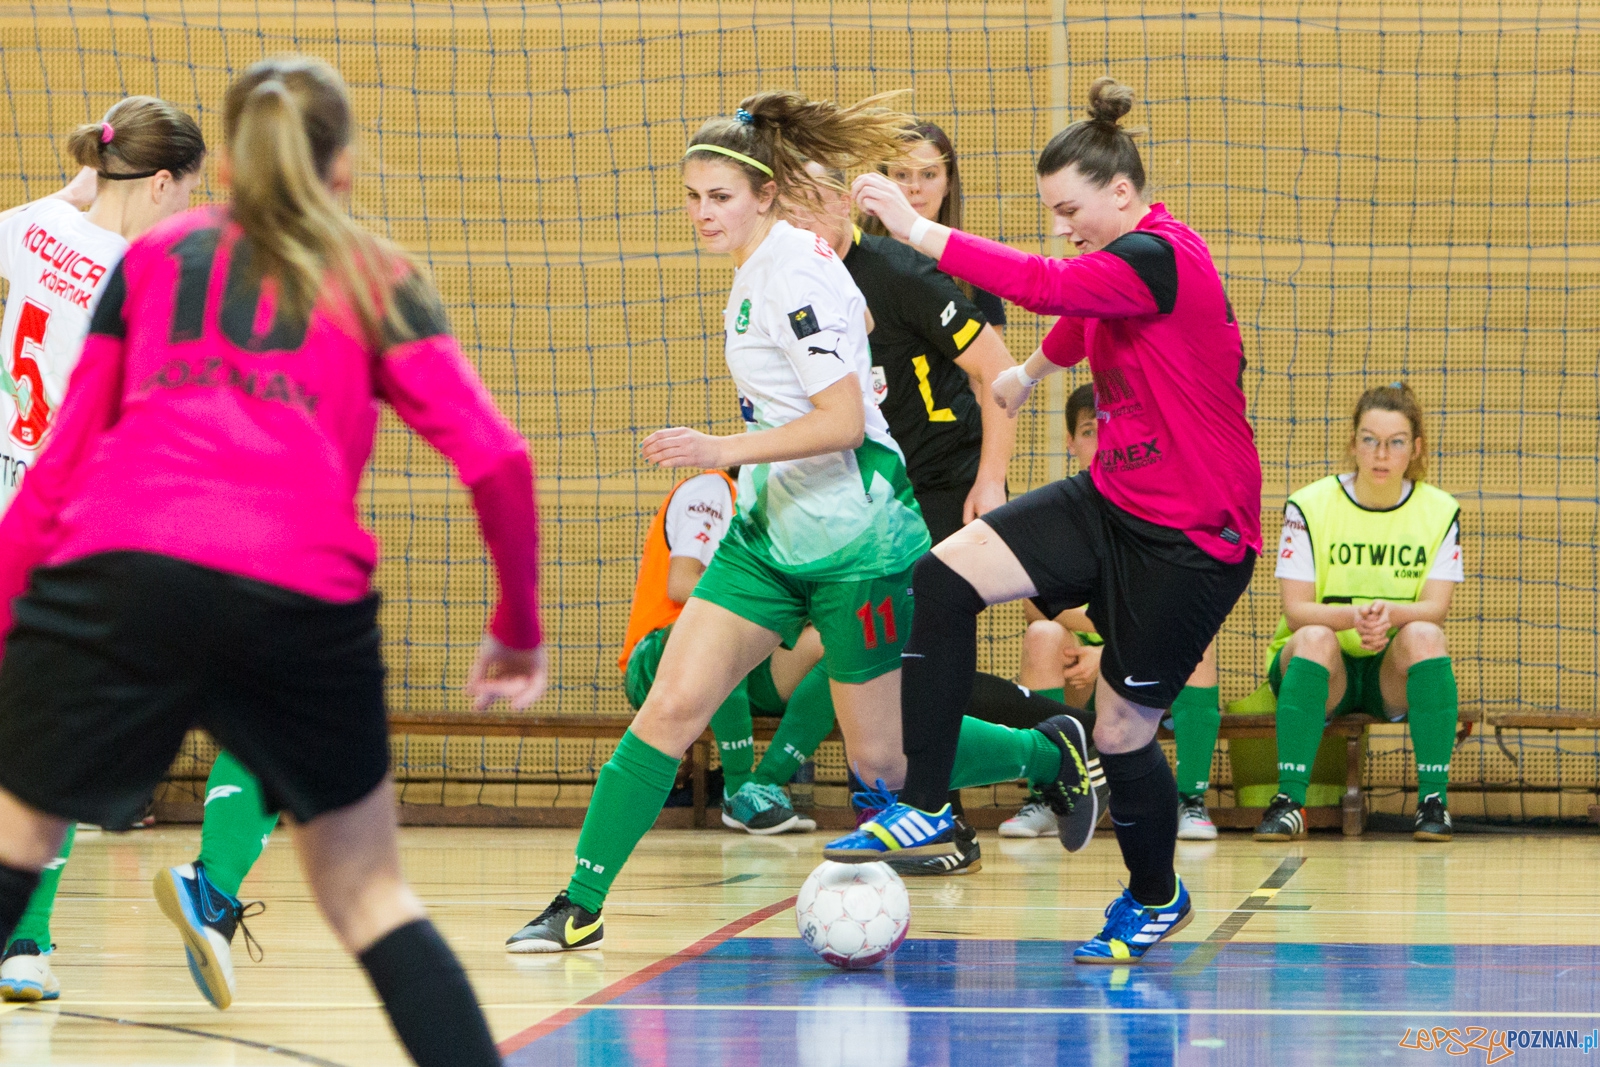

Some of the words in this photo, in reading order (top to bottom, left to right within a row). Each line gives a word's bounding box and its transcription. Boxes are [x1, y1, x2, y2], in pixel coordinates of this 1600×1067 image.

[167, 227, 313, 353] 10
[8, 296, 52, 450] 5
[856, 595, 898, 650] 11
